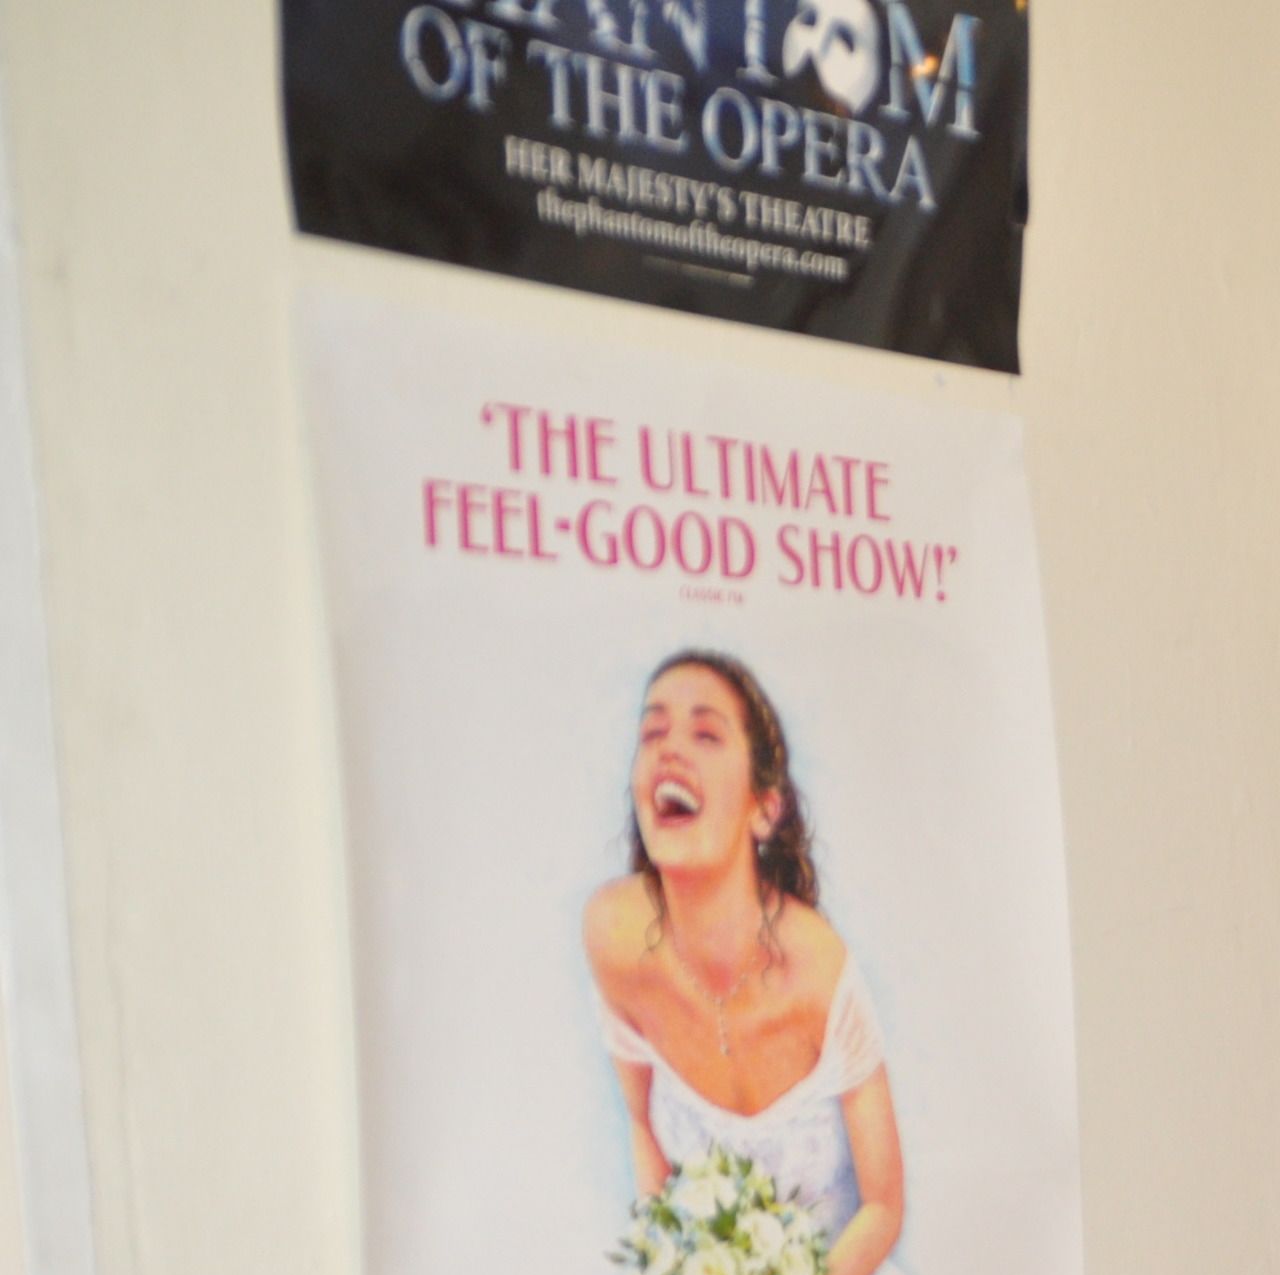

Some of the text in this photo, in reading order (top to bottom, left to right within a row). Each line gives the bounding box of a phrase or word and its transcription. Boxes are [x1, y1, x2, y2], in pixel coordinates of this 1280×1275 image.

[402, 4, 937, 213] OF THE OPERA
[505, 135, 872, 251] HER MAJESTY'S THEATRE
[537, 185, 850, 283] thephantomoftheopera.com
[638, 424, 891, 523] ULTIMATE
